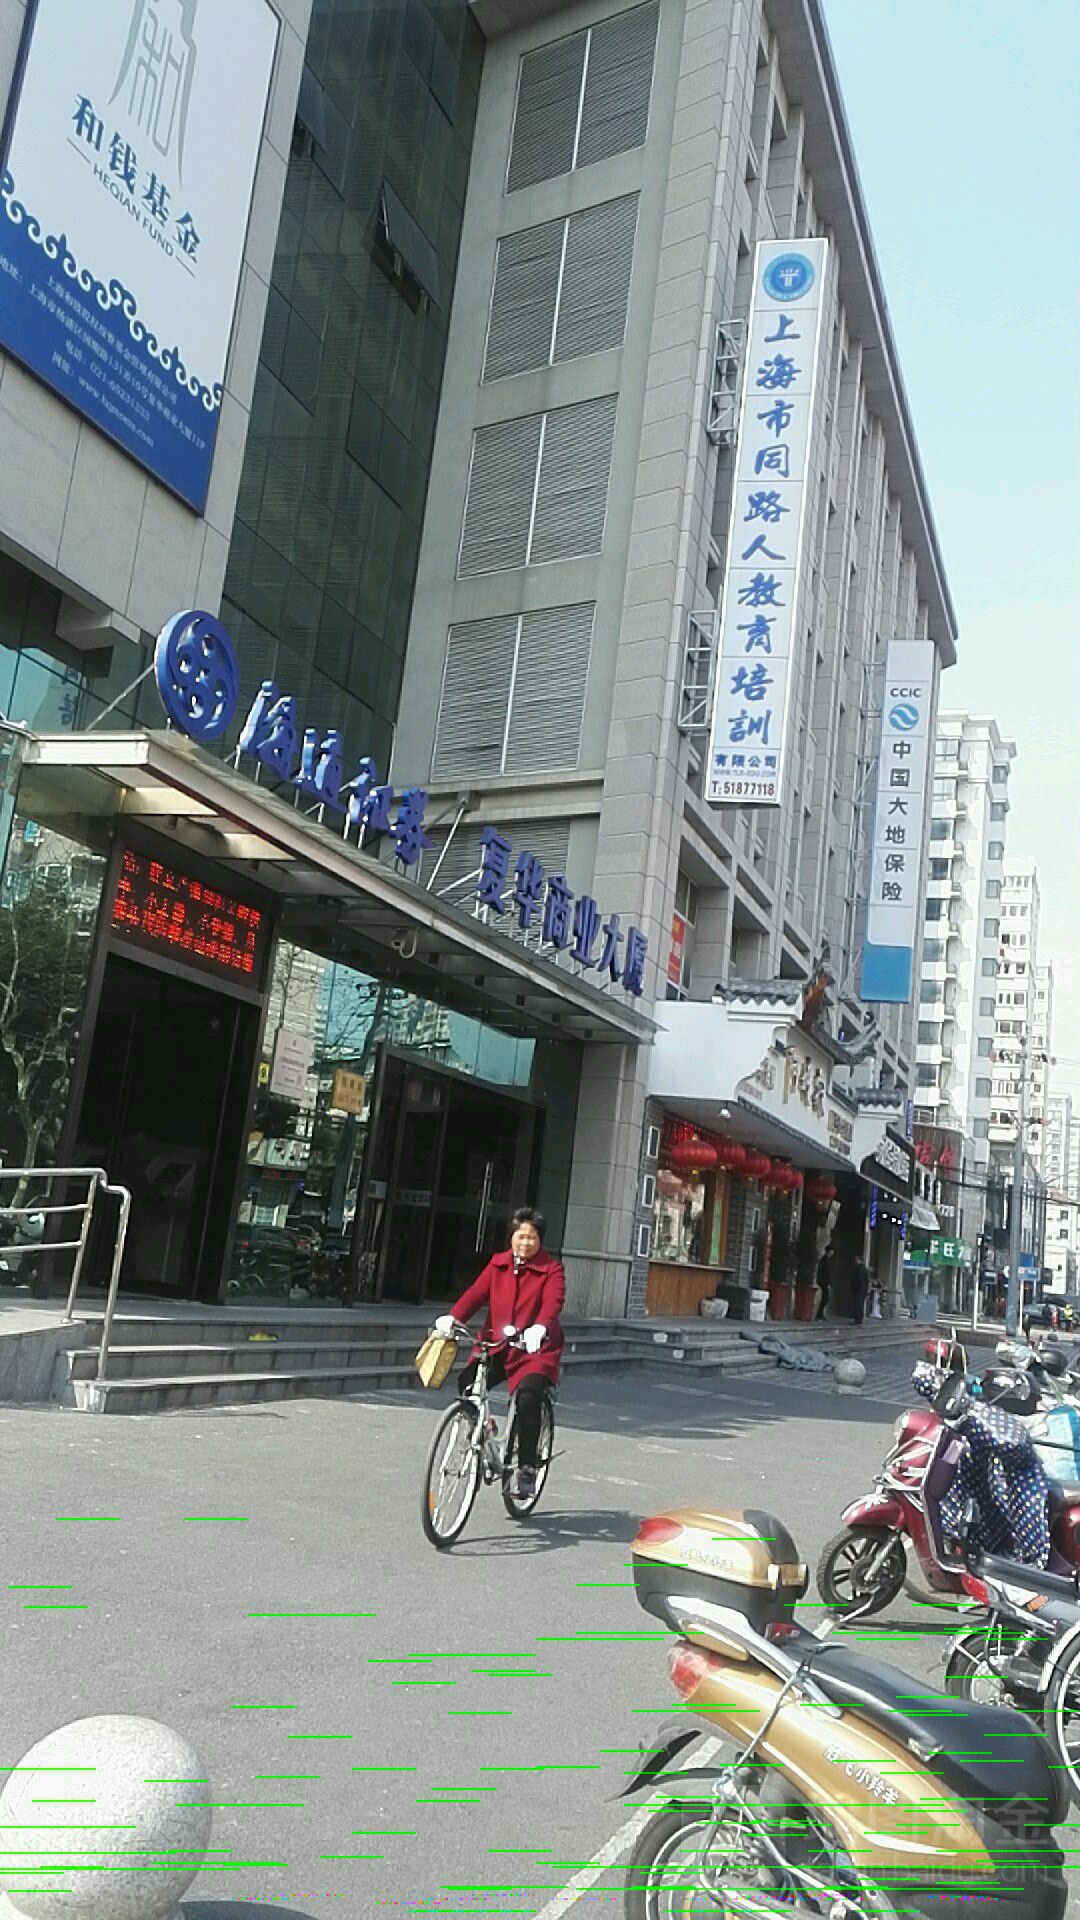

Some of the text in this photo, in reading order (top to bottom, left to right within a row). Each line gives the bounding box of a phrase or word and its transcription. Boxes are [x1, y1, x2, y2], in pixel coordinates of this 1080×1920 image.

[72, 93, 200, 263] 和钱基金
[93, 163, 174, 257] HEQIAN FUND
[239, 680, 434, 864] 海通证券
[714, 753, 777, 769] 有限公司
[890, 687, 922, 698] CCIC
[882, 740, 911, 902] 中国大地保险
[478, 825, 649, 997] 复华商业大厦
